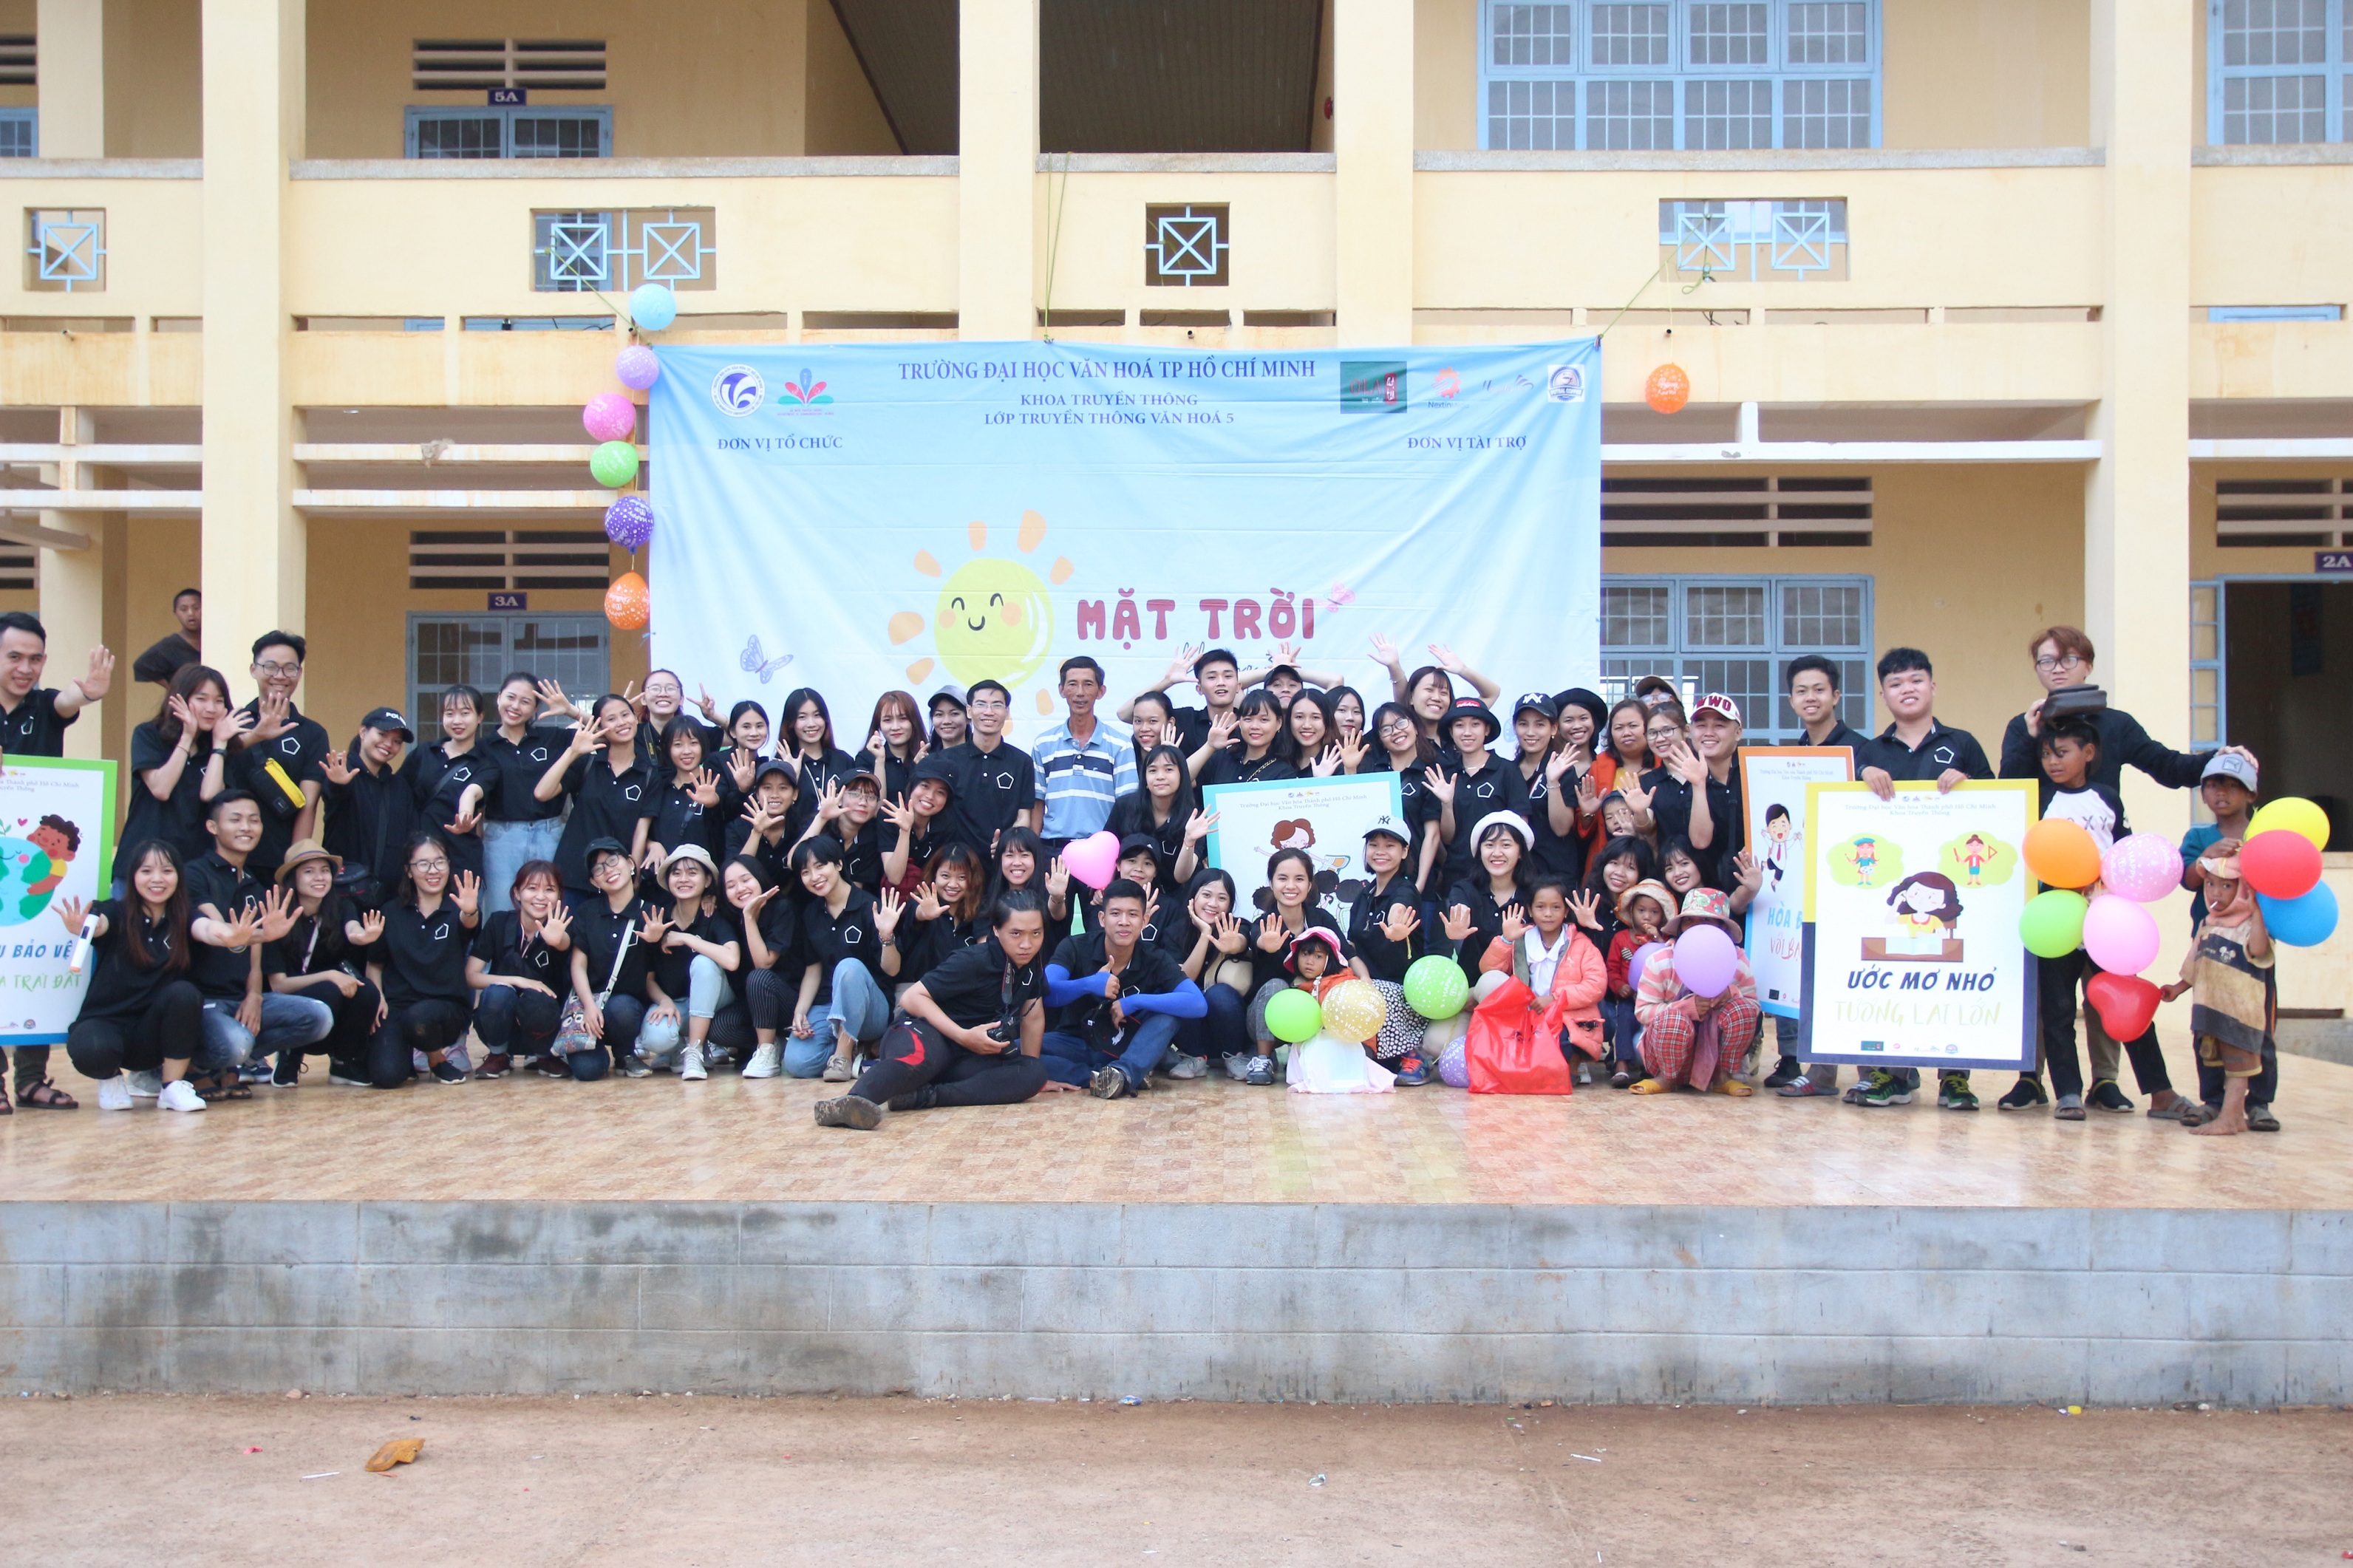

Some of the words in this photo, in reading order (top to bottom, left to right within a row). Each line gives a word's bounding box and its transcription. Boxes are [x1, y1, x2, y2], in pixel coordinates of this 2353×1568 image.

[495, 92, 518, 102] 5A
[899, 359, 977, 380] TRƯỜNG
[984, 361, 1017, 383] ĐẠI
[1023, 361, 1064, 382] HỌC
[1069, 358, 1107, 378] VĂN
[1113, 358, 1154, 378] HOÁ
[1159, 361, 1182, 378] TP
[1188, 355, 1216, 378] HỒ
[1222, 357, 1256, 378] CHÍ
[1261, 361, 1315, 378] MINH
[1350, 378, 1382, 395] OLA
[1021, 395, 1066, 406] KHOA
[1071, 390, 1135, 406] TRUYỀN
[1140, 392, 1197, 406] THÔNG
[984, 411, 1015, 425] LỚP
[1019, 409, 1083, 424] TRUYỀN
[1088, 411, 1145, 424] THÔNG
[1151, 411, 1182, 423] VĂN
[1187, 411, 1221, 423] HOÁ
[1226, 413, 1234, 423] 5
[718, 437, 751, 449] ĐƠN
[755, 438, 771, 451] VỊ
[775, 434, 795, 449] TỔ
[800, 435, 842, 449] CHỨC
[1408, 437, 1441, 449] ĐƠN
[1446, 437, 1462, 451] VỊ
[1467, 435, 1491, 449] TÀI
[1495, 435, 1526, 450] TRỢ
[2323, 555, 2352, 568] 2A
[495, 596, 518, 607] 3A
[1077, 587, 1175, 650] MẶT
[1199, 587, 1314, 640] TRỜI
[2068, 815, 2108, 831] XY
[13, 938, 47, 958] BẢO
[54, 940, 72, 960] VỆ
[1782, 937, 1801, 962] BẠ
[1848, 964, 1893, 989] ƯỚC
[1899, 969, 1941, 990] MƠ
[1946, 967, 1997, 992] NHỎ
[1913, 1003, 1950, 1026] LAI
